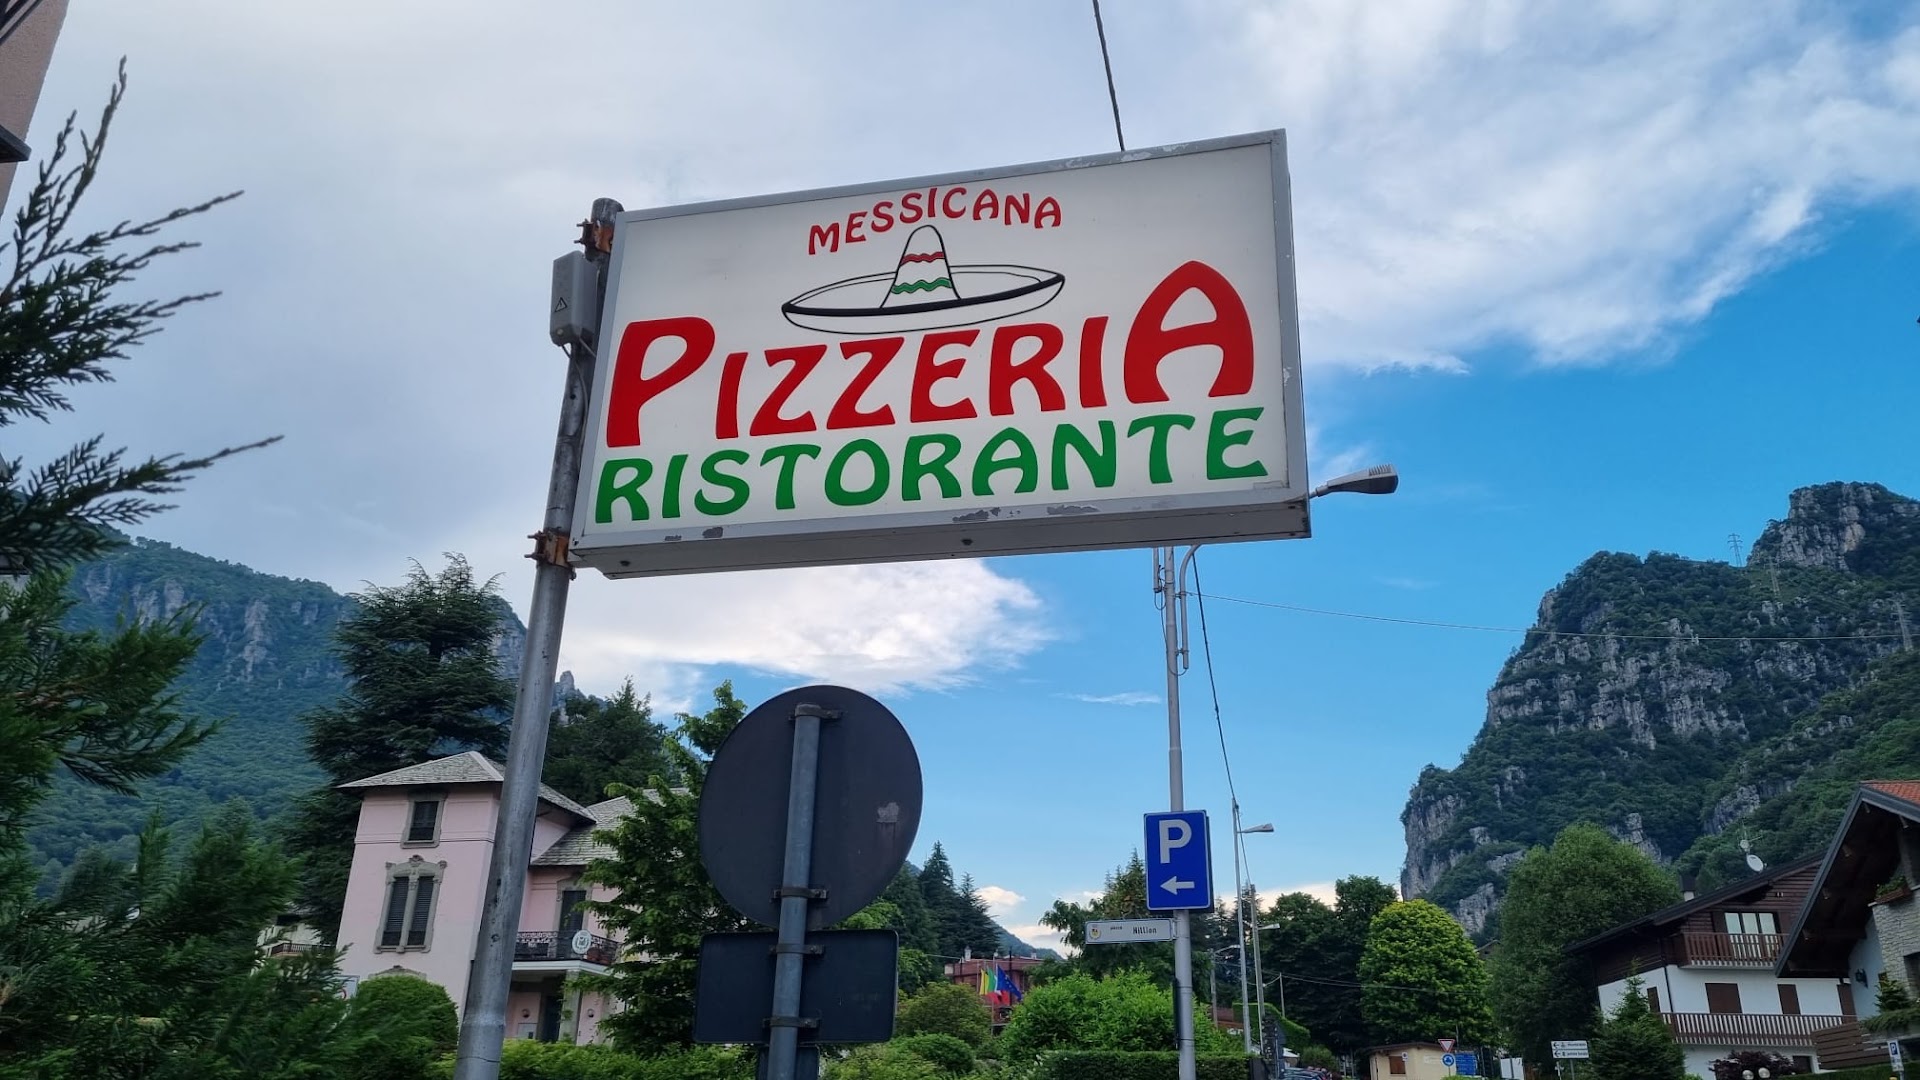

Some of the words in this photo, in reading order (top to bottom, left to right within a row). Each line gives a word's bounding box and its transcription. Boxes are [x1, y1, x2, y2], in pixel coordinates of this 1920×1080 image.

[808, 187, 1062, 255] MESSICANA
[606, 260, 1254, 448] PIZZERIA
[595, 407, 1268, 524] RISTORANTE
[1158, 819, 1192, 864] P
